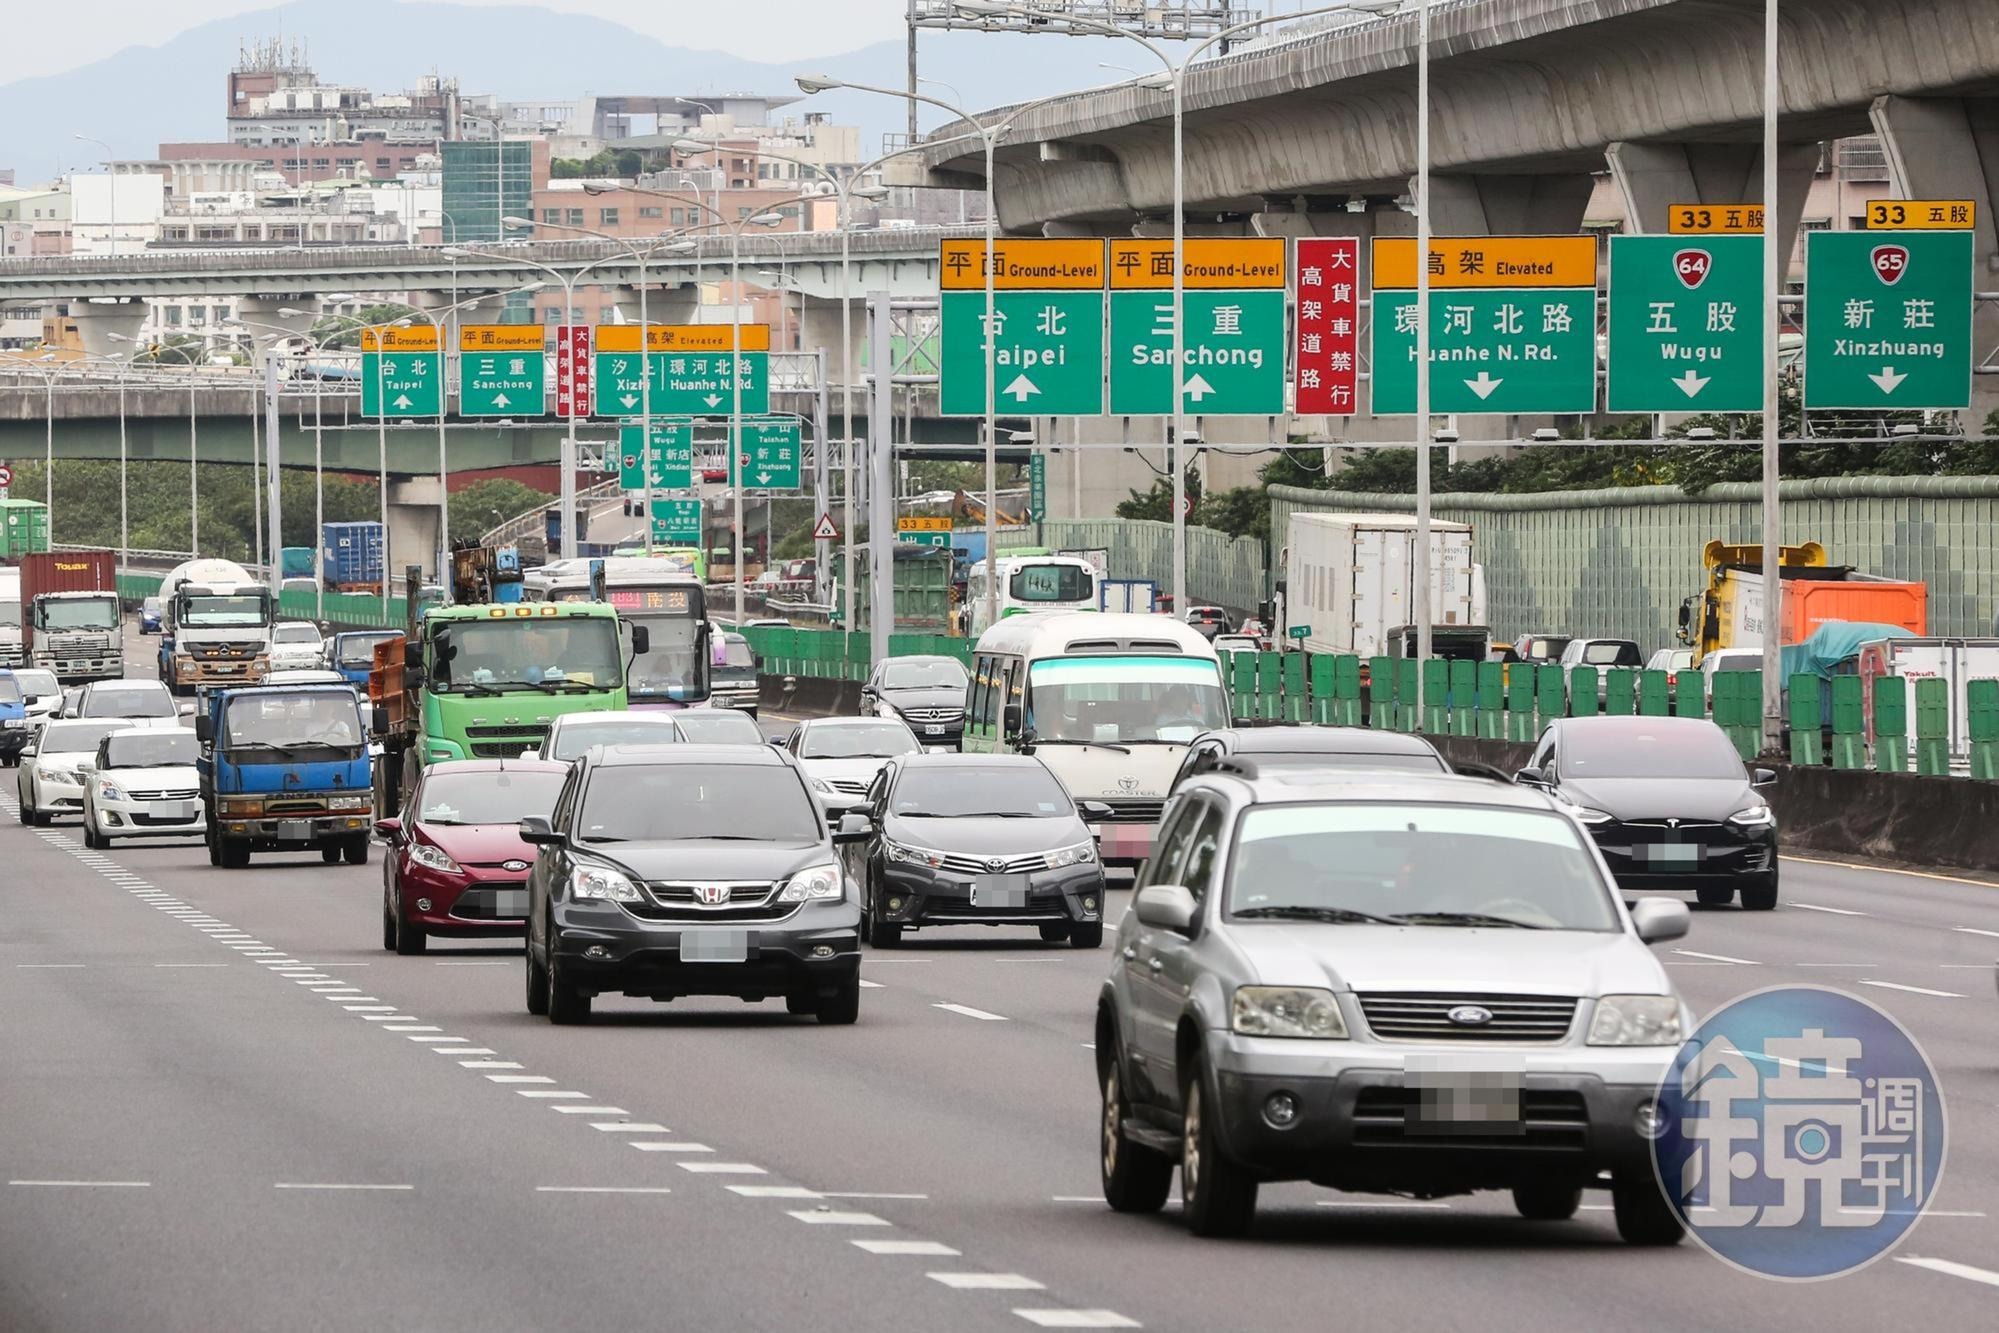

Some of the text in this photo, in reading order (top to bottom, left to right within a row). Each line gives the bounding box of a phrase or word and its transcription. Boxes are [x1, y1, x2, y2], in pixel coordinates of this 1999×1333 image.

[1680, 210, 1764, 229] 33 五股
[1873, 205, 1968, 225] 33 五股
[946, 252, 1097, 277] 平面 Ground-Level
[1116, 251, 1279, 277] 平面 Ground-Level
[1427, 251, 1552, 276] 高架 Elevated
[1679, 257, 1706, 274] 64
[1876, 254, 1903, 271] 65
[977, 305, 1067, 336] 台北
[1151, 304, 1243, 335] 三重
[1394, 303, 1573, 335] 環河北路
[1646, 302, 1737, 333] 五股
[1844, 298, 1935, 329] 新莊
[1301, 265, 1322, 389] 高架道路
[1331, 248, 1352, 405] 大貨車禁行
[365, 331, 443, 346] 平面 Ground-Levl
[464, 331, 542, 346] 平面 Ground-Level
[646, 331, 723, 345] 高架 Elevated
[1498, 345, 1519, 361] N.
[1524, 344, 1558, 361] Rd.
[1661, 343, 1722, 363] Wugu
[1833, 339, 1945, 359] Xinzhuang
[381, 359, 427, 376] 台北
[479, 358, 526, 375] 三重
[576, 330, 587, 411] 大貨車禁行
[611, 359, 656, 376] 汐止
[669, 358, 753, 376] 環河北路
[386, 380, 422, 391] Taipei
[473, 380, 533, 391] Sanchong
[670, 378, 717, 391] Huanhe
[720, 379, 732, 391] N.
[901, 519, 948, 529] 33 五股
[646, 592, 685, 608] 南投
